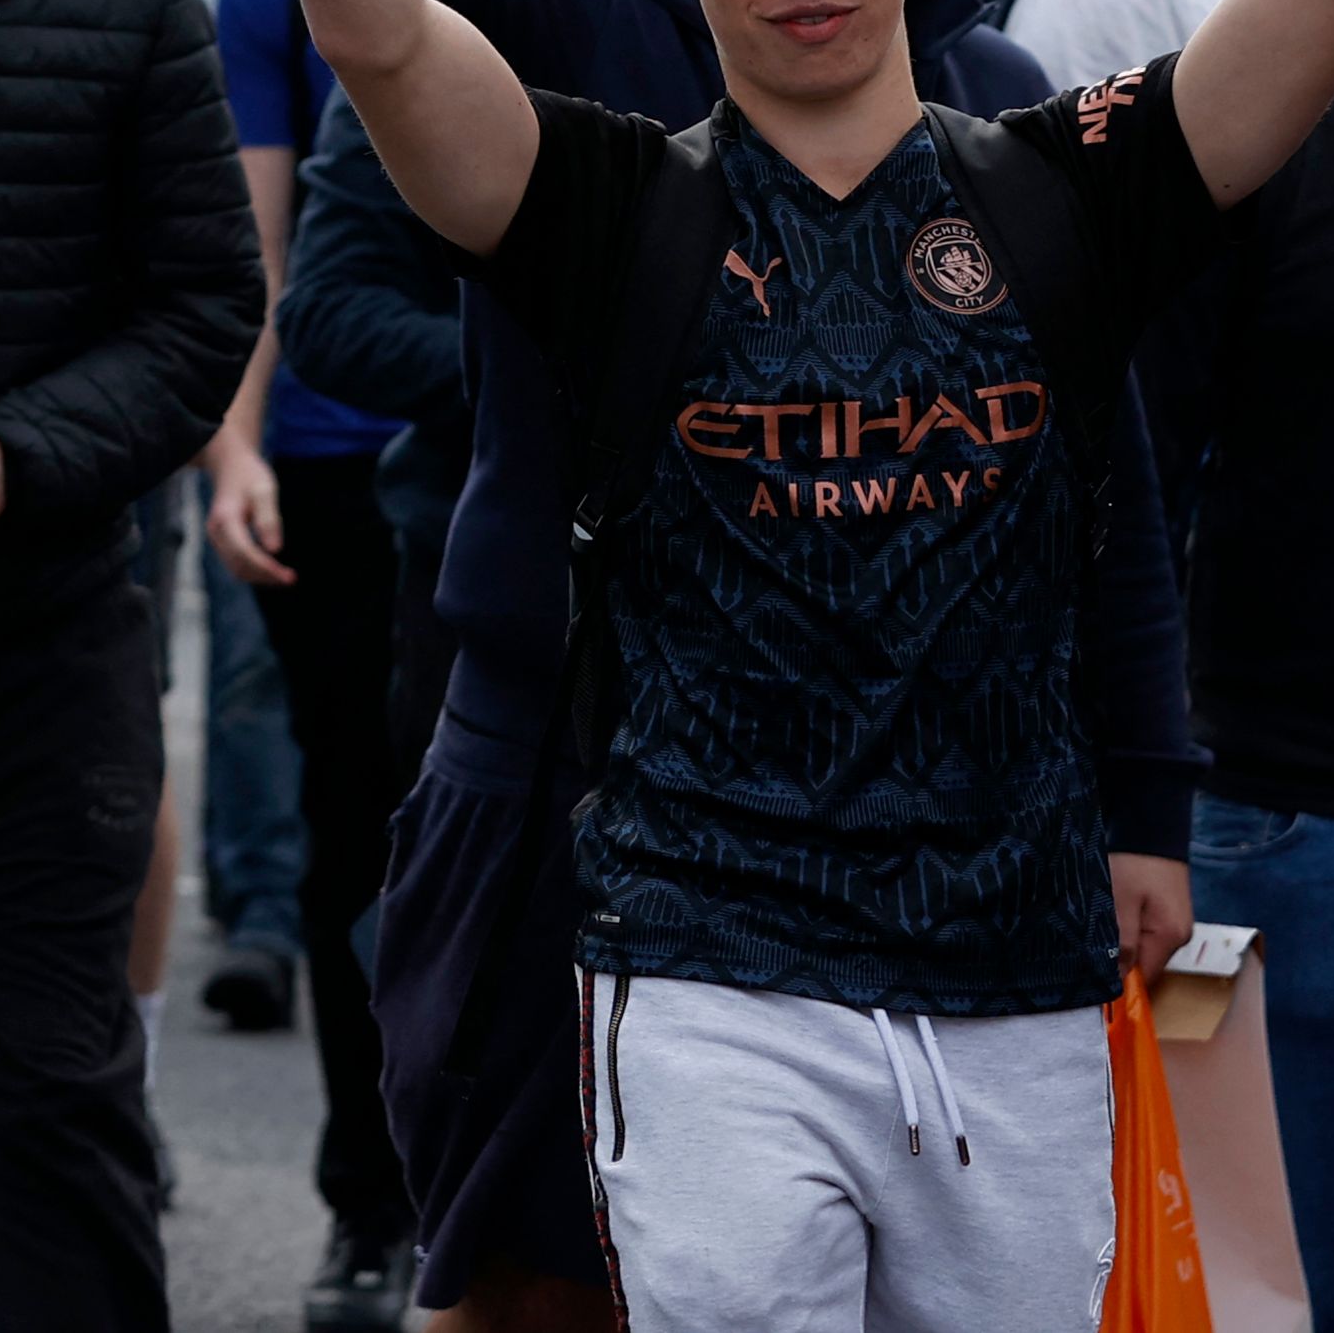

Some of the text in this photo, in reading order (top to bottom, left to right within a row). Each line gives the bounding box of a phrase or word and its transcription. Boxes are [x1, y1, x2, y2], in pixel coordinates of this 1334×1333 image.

[914, 225, 983, 259] MANCHEST
[954, 295, 985, 308] CITY
[676, 380, 1048, 461] ETIHAD
[748, 467, 1003, 518] AIRWAYS
